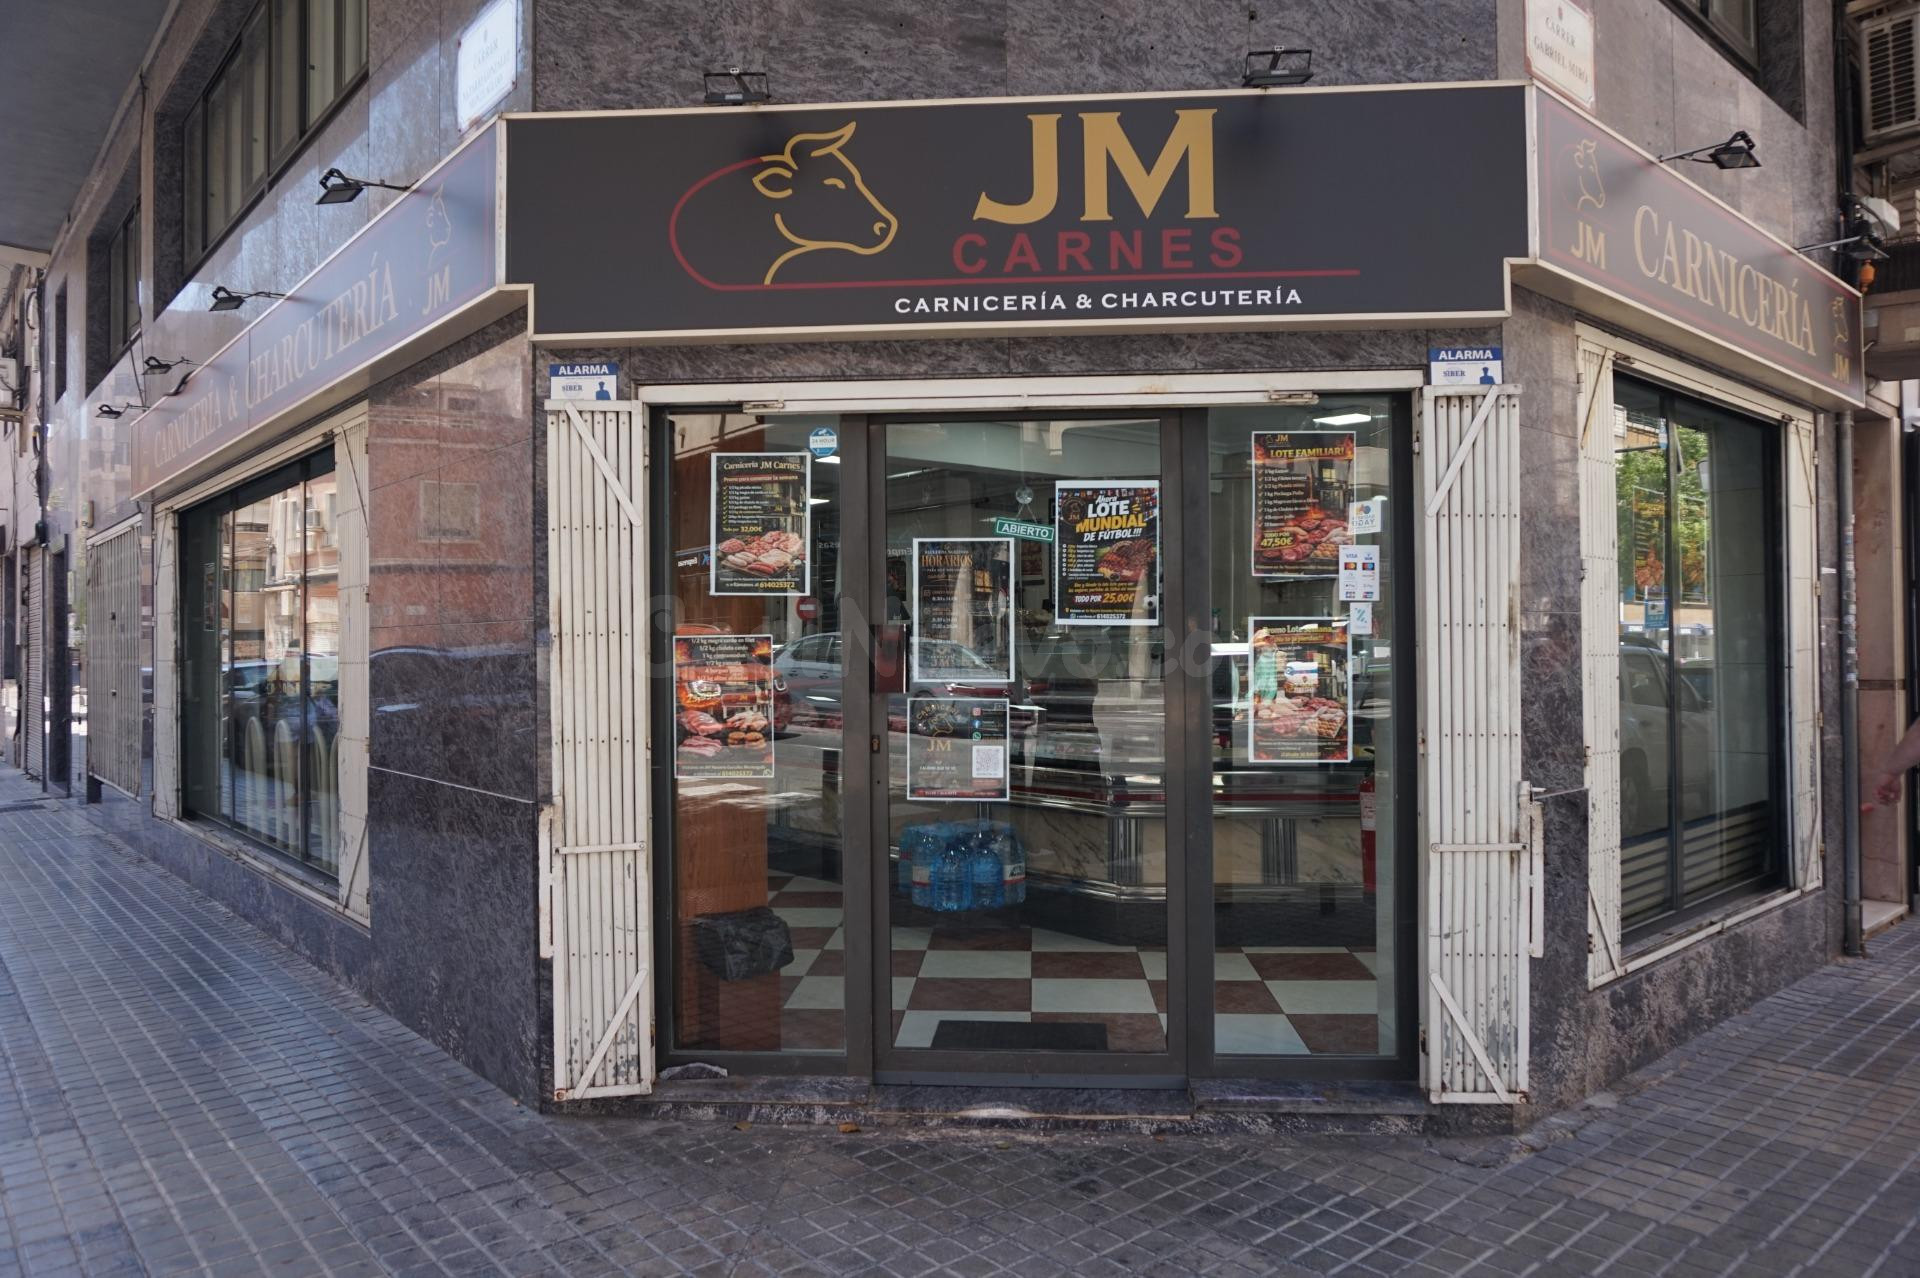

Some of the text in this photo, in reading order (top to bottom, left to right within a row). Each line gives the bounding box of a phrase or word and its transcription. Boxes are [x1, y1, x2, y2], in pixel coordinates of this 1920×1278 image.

[1545, 16, 1575, 48] CARRER
[1534, 35, 1565, 67] GABRIEL
[973, 107, 1219, 225] JM
[952, 227, 1245, 274] CARNES
[1570, 220, 1606, 270] JM
[421, 264, 450, 316] JM
[1634, 205, 1817, 357] CARNICERÍA
[894, 285, 1303, 315] CARNICERÍA & CHARCUTERÍA
[153, 251, 399, 468] CARNICERÍA & CHARCUTERÍA
[1438, 349, 1494, 360] ALARMA
[558, 364, 609, 376] ALARMA
[1831, 352, 1850, 385] JM
[1275, 434, 1289, 442] JM
[1270, 447, 1344, 458] LOTE FAMILIAR!
[760, 460, 772, 470] JM
[773, 461, 800, 470] Carnes
[1087, 499, 1130, 518] LOTE
[1001, 523, 1049, 538] ABIERTO
[1075, 512, 1147, 533] MUNDIAL
[1083, 531, 1096, 542] DE
[1260, 537, 1293, 547] 47,50€
[921, 554, 973, 567] HORARIOS
[1074, 592, 1135, 604] TODO POR 25,00€
[927, 739, 951, 752] JM
